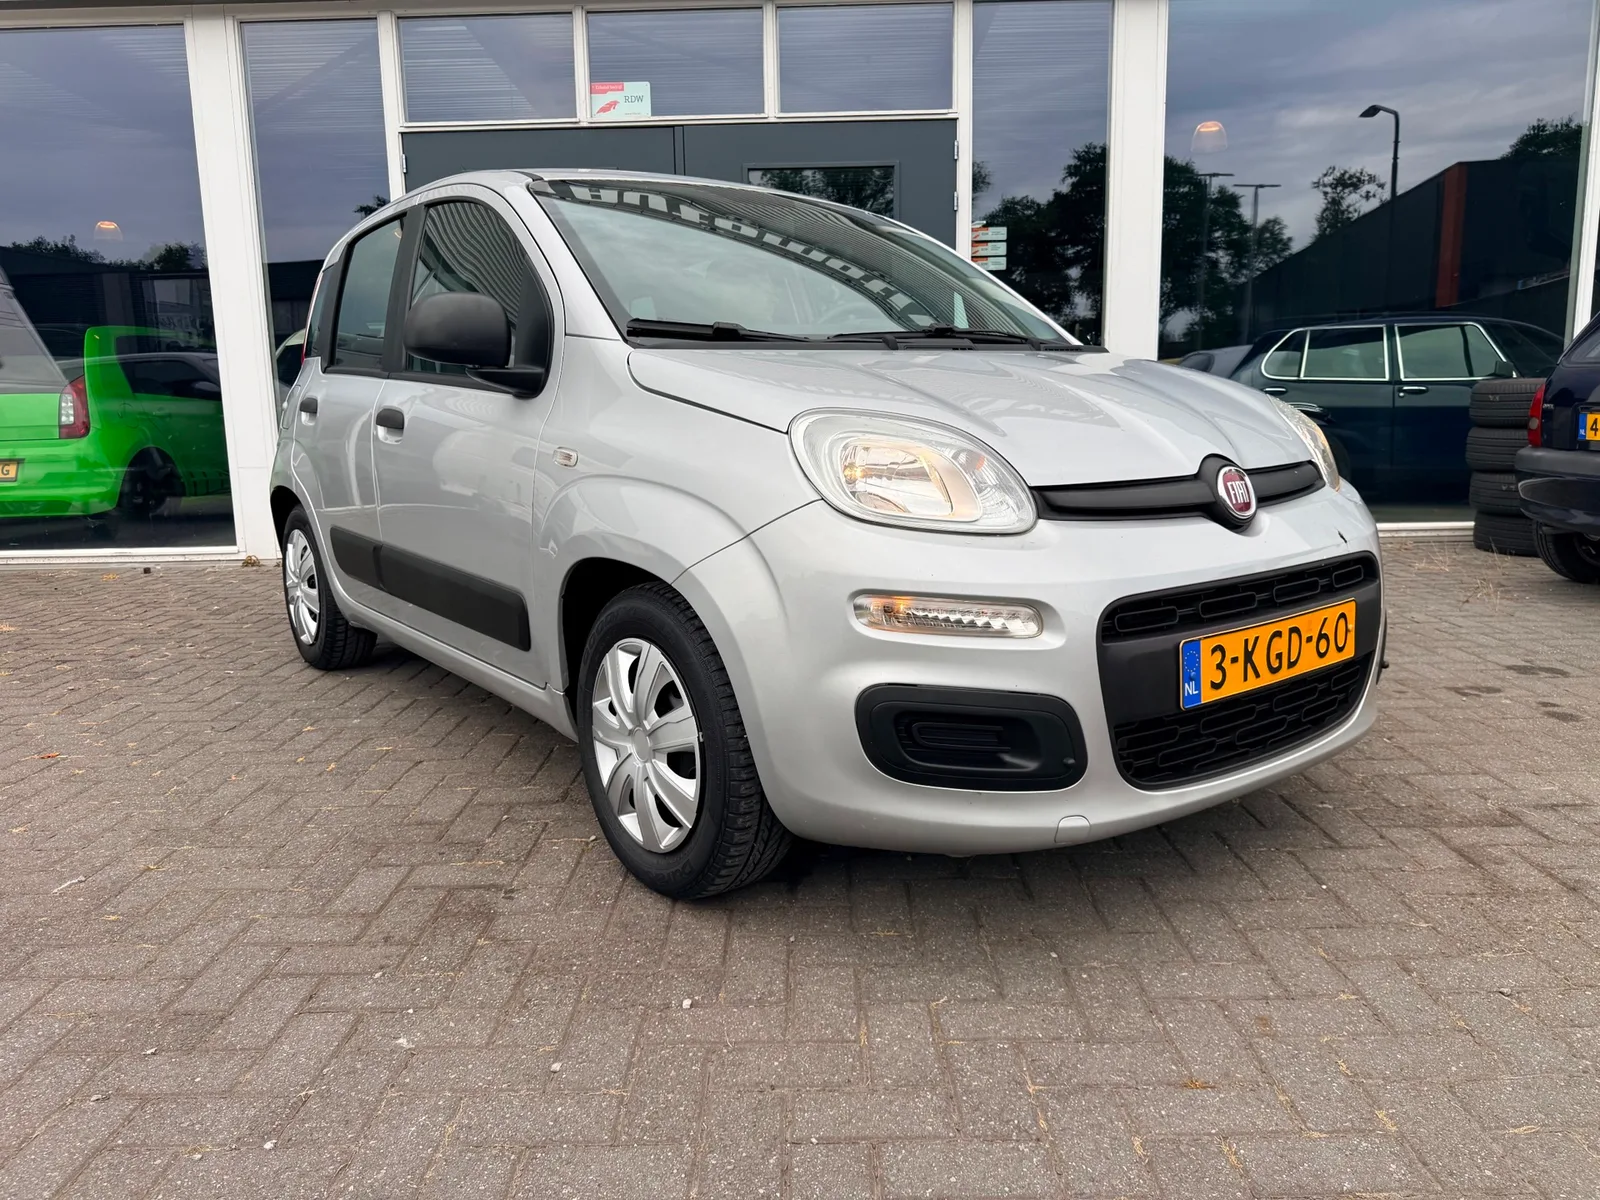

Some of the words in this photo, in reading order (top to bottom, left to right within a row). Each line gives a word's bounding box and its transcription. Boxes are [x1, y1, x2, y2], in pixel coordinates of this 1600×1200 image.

[624, 95, 644, 103] RDW
[1227, 481, 1250, 504] FIAT
[1210, 612, 1348, 690] 3-KGD-60
[1184, 681, 1199, 697] NL
